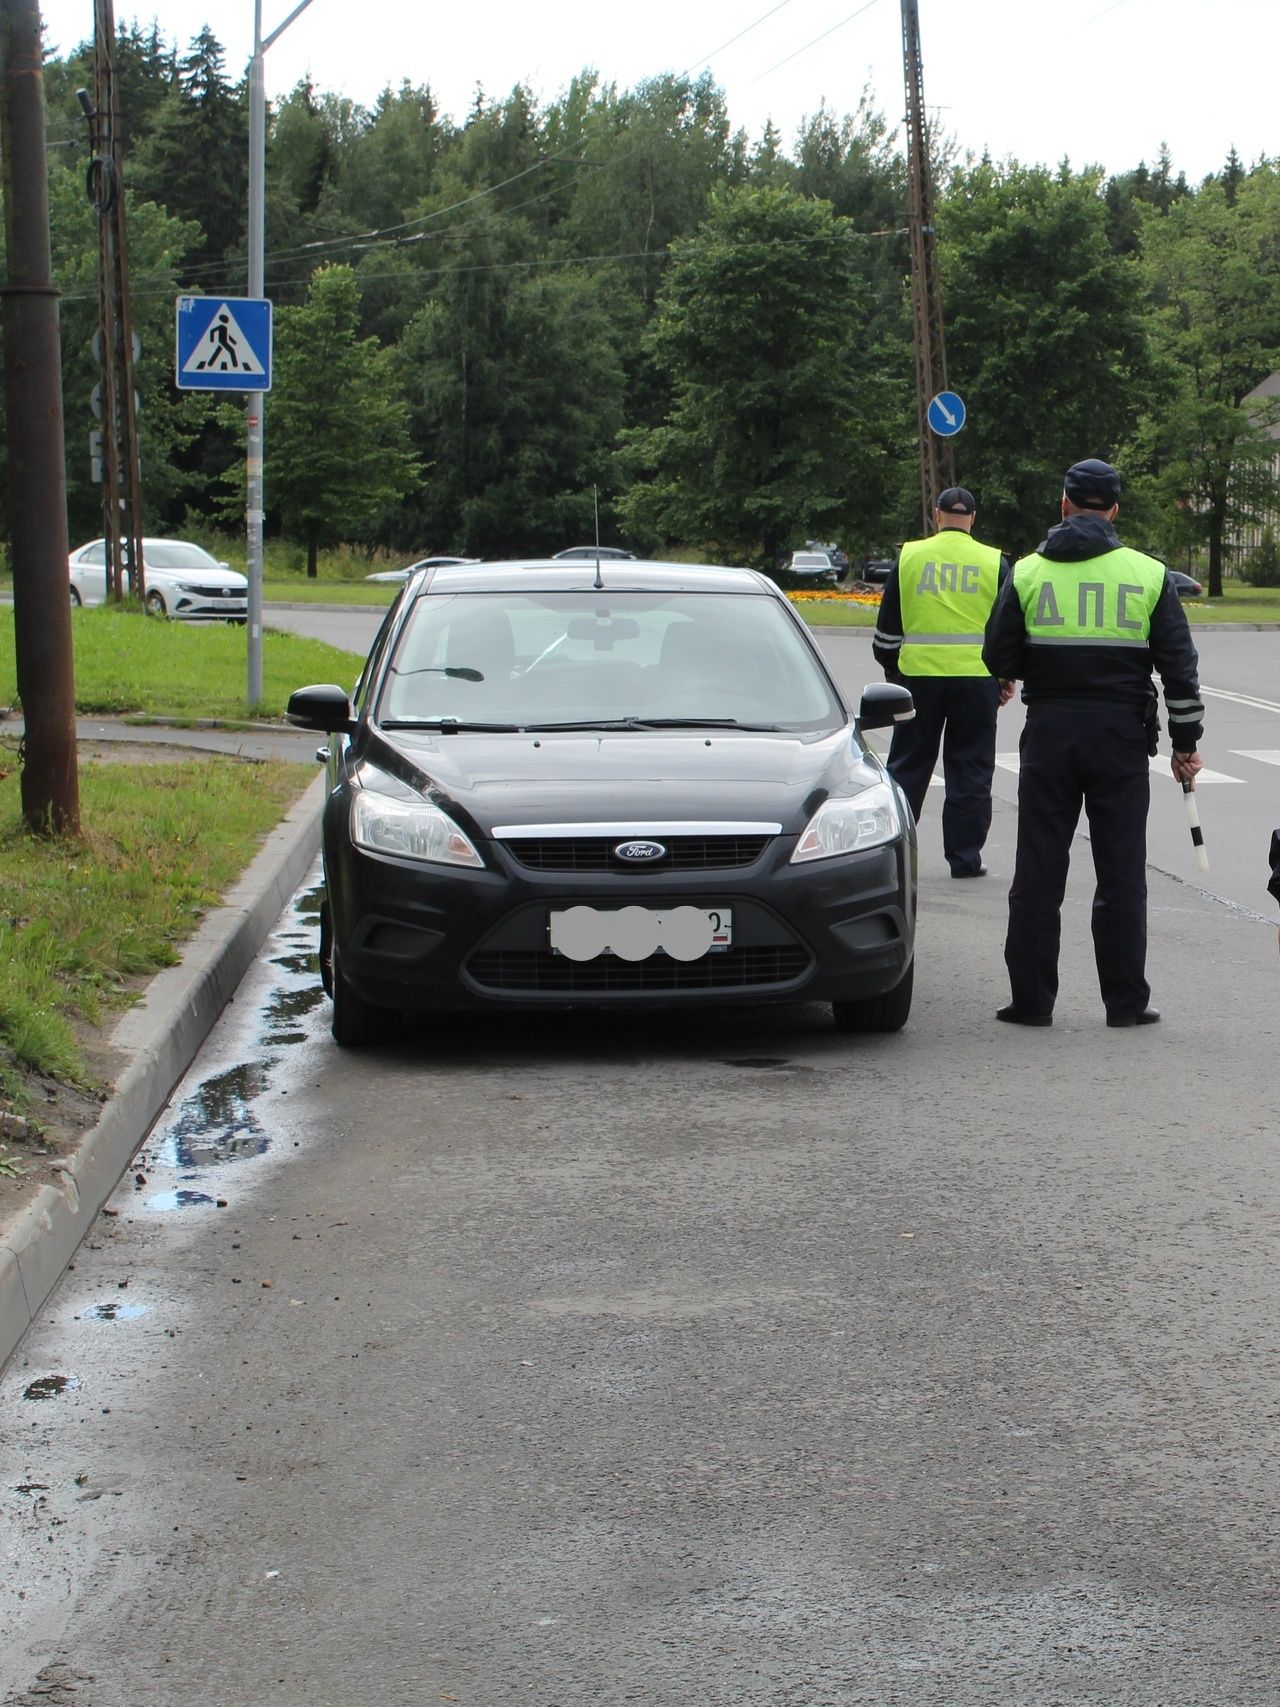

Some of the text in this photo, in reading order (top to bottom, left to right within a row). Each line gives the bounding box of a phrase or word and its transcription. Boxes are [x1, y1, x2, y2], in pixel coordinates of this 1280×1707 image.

[917, 561, 979, 595] ДПС
[1033, 582, 1144, 630] ДПС
[626, 845, 654, 857] Ford
